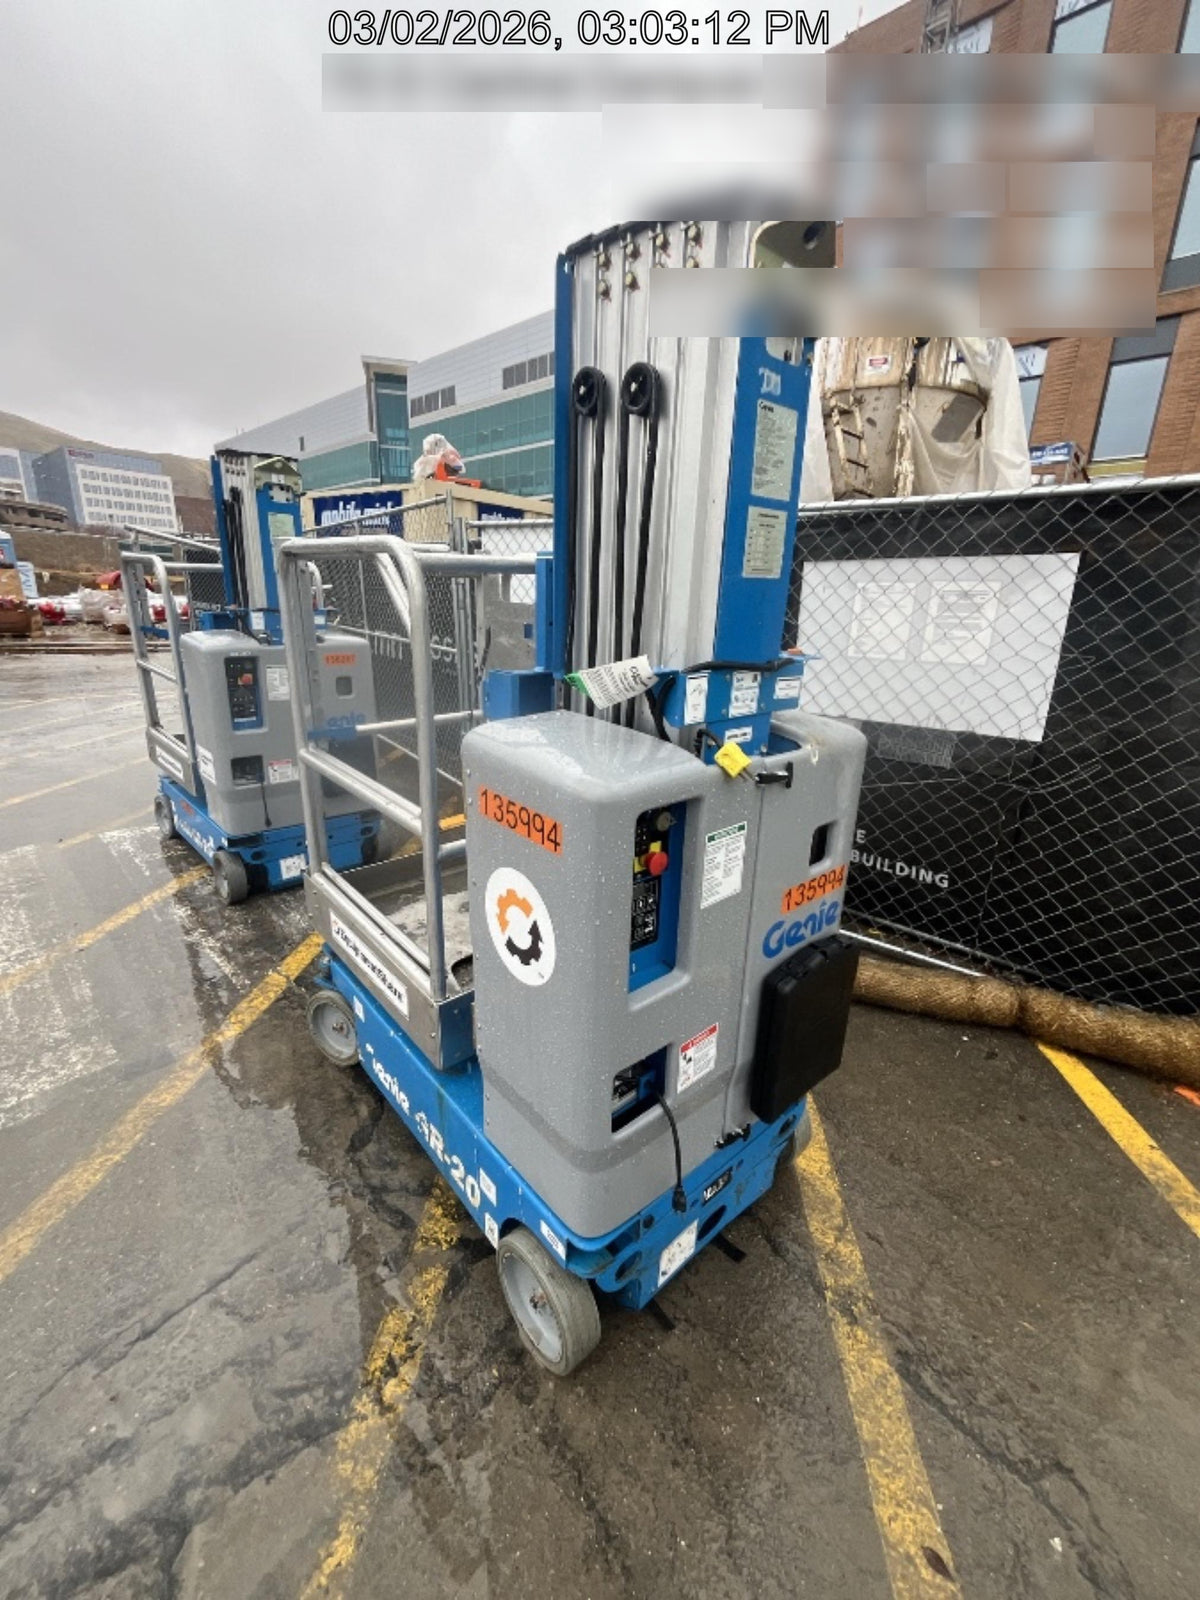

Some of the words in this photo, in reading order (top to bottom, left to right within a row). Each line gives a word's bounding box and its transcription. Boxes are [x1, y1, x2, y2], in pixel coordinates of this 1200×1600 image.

[480, 788, 561, 853] 135994
[785, 864, 846, 911] 135994
[850, 849, 950, 889] BUILDING
[762, 900, 839, 959] Genie
